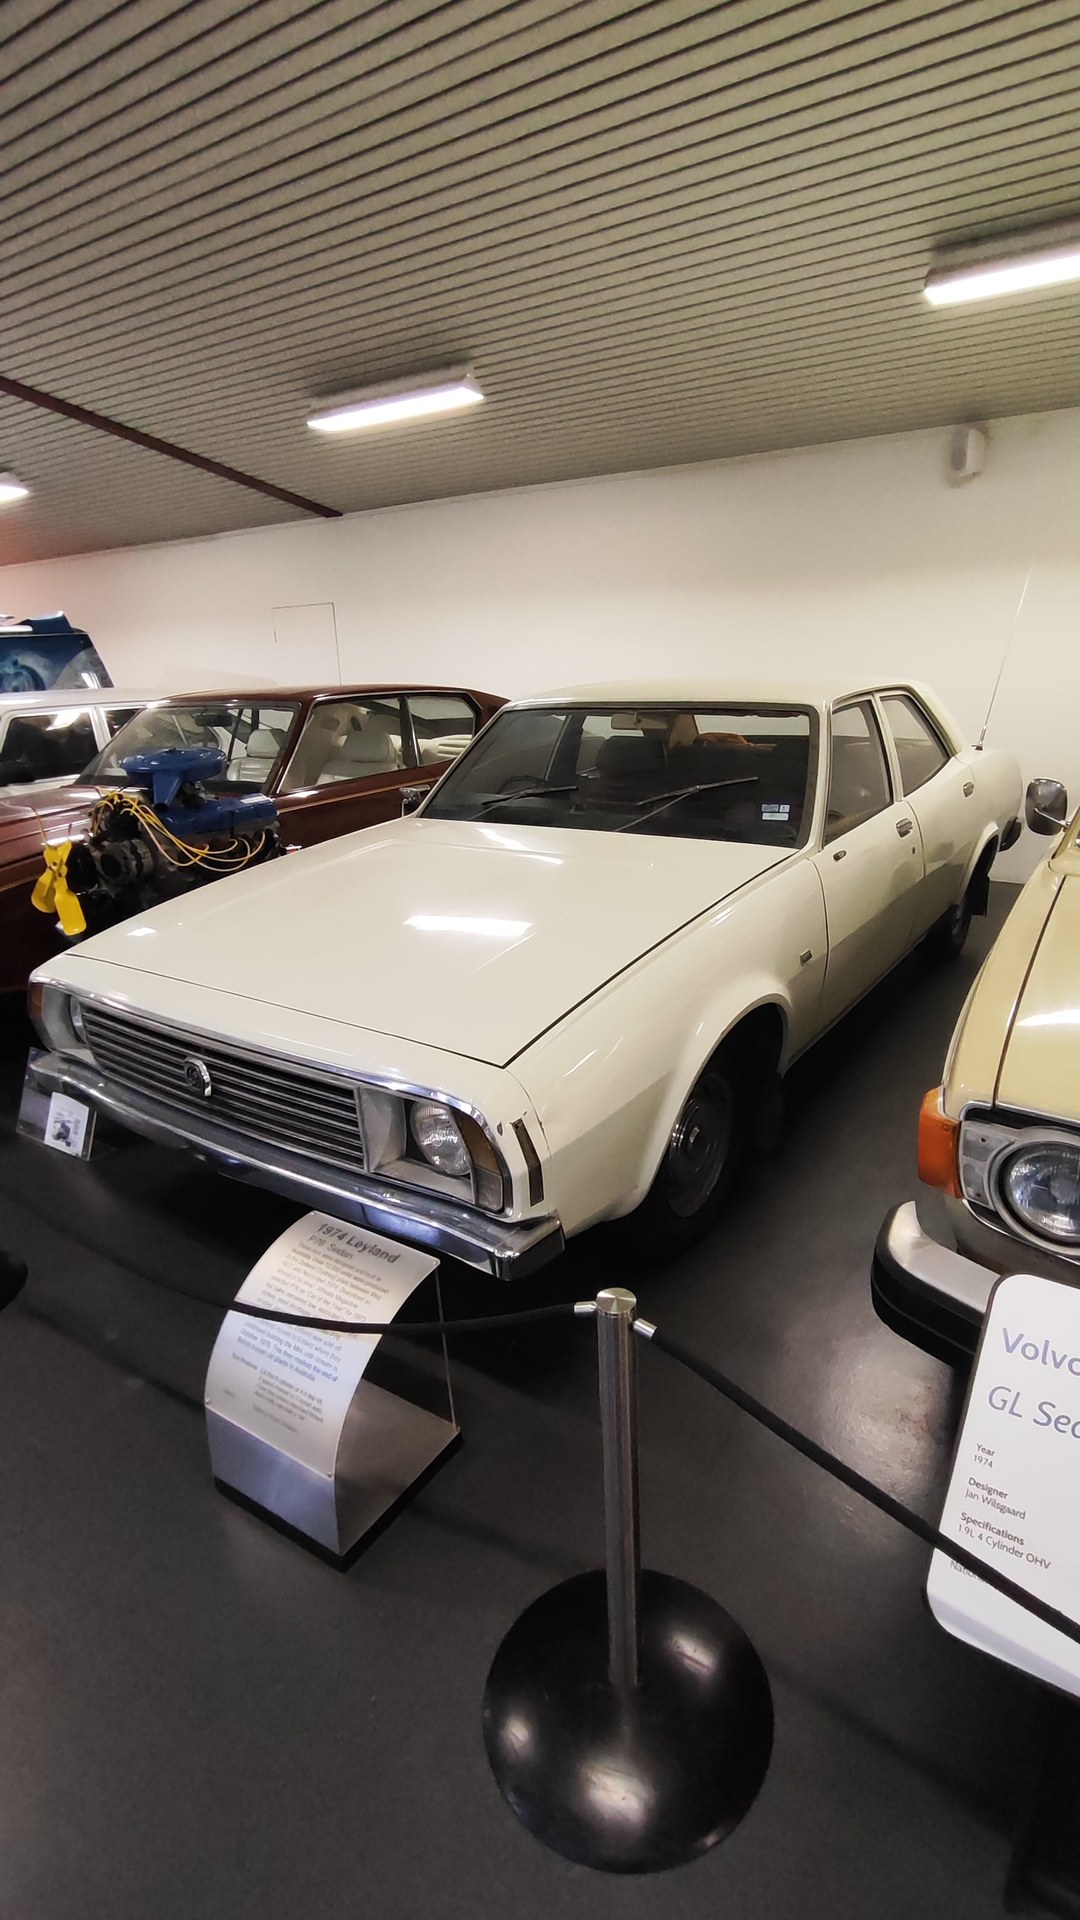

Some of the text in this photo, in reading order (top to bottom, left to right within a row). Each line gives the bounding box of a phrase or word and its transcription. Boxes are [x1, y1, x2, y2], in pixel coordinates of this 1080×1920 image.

[316, 1223, 349, 1241] 1974
[346, 1235, 401, 1264] Leyland
[327, 1243, 354, 1260] Sedan
[988, 1386, 1023, 1418] GL
[973, 1455, 994, 1468] 1974
[976, 1443, 995, 1457] Year
[968, 1477, 1008, 1500] Designer
[965, 1489, 1027, 1520] Jan Wilsgaard
[960, 1512, 1025, 1546] Specifications
[958, 1524, 1052, 1570] 1.9L 4 Cylinder OHV
